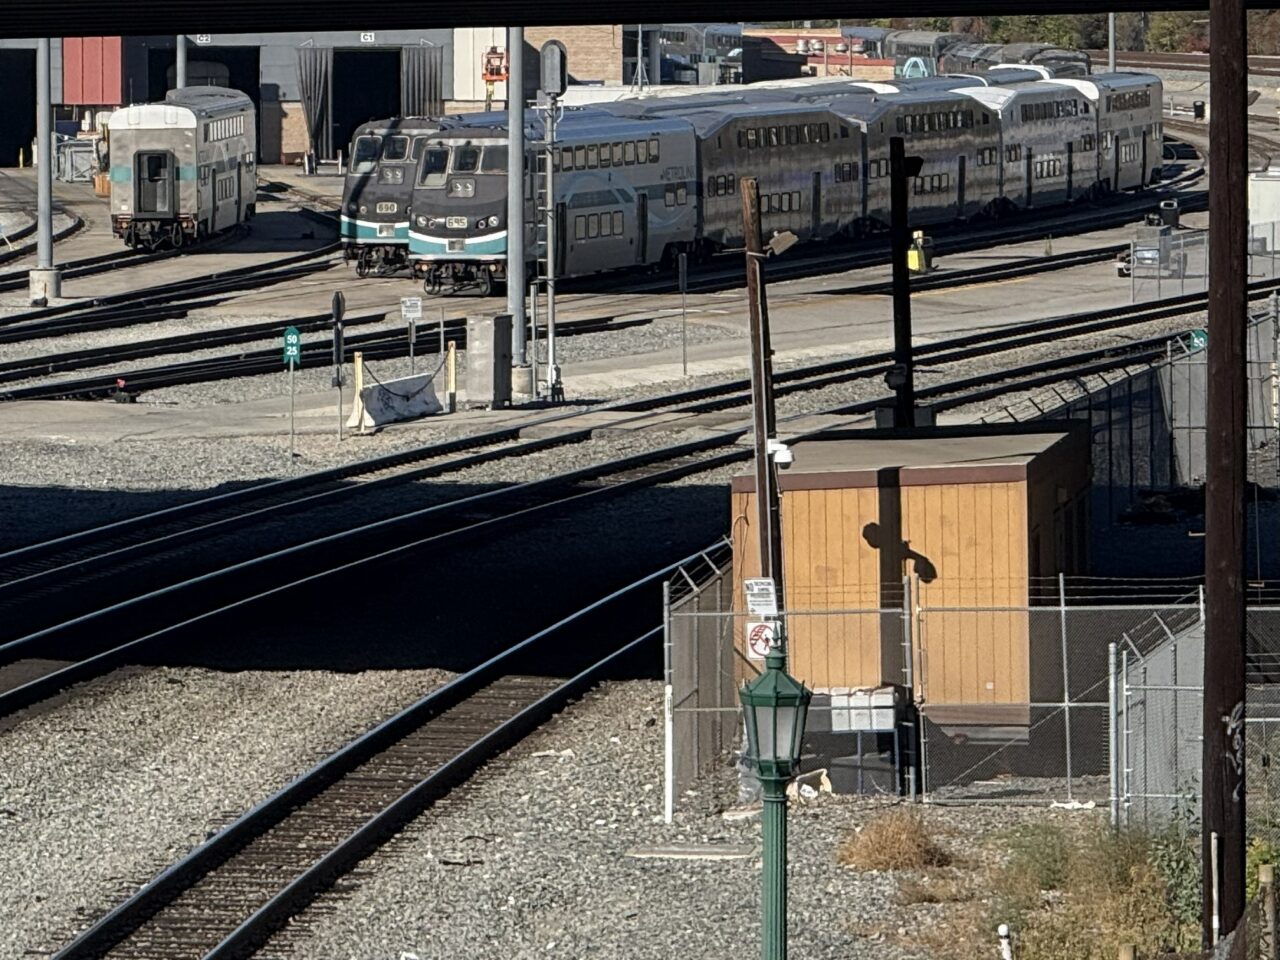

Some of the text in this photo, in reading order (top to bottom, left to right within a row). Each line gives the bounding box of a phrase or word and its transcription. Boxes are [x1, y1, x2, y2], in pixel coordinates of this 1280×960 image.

[378, 203, 396, 212] 690
[287, 335, 298, 344] 50
[287, 346, 298, 355] 25
